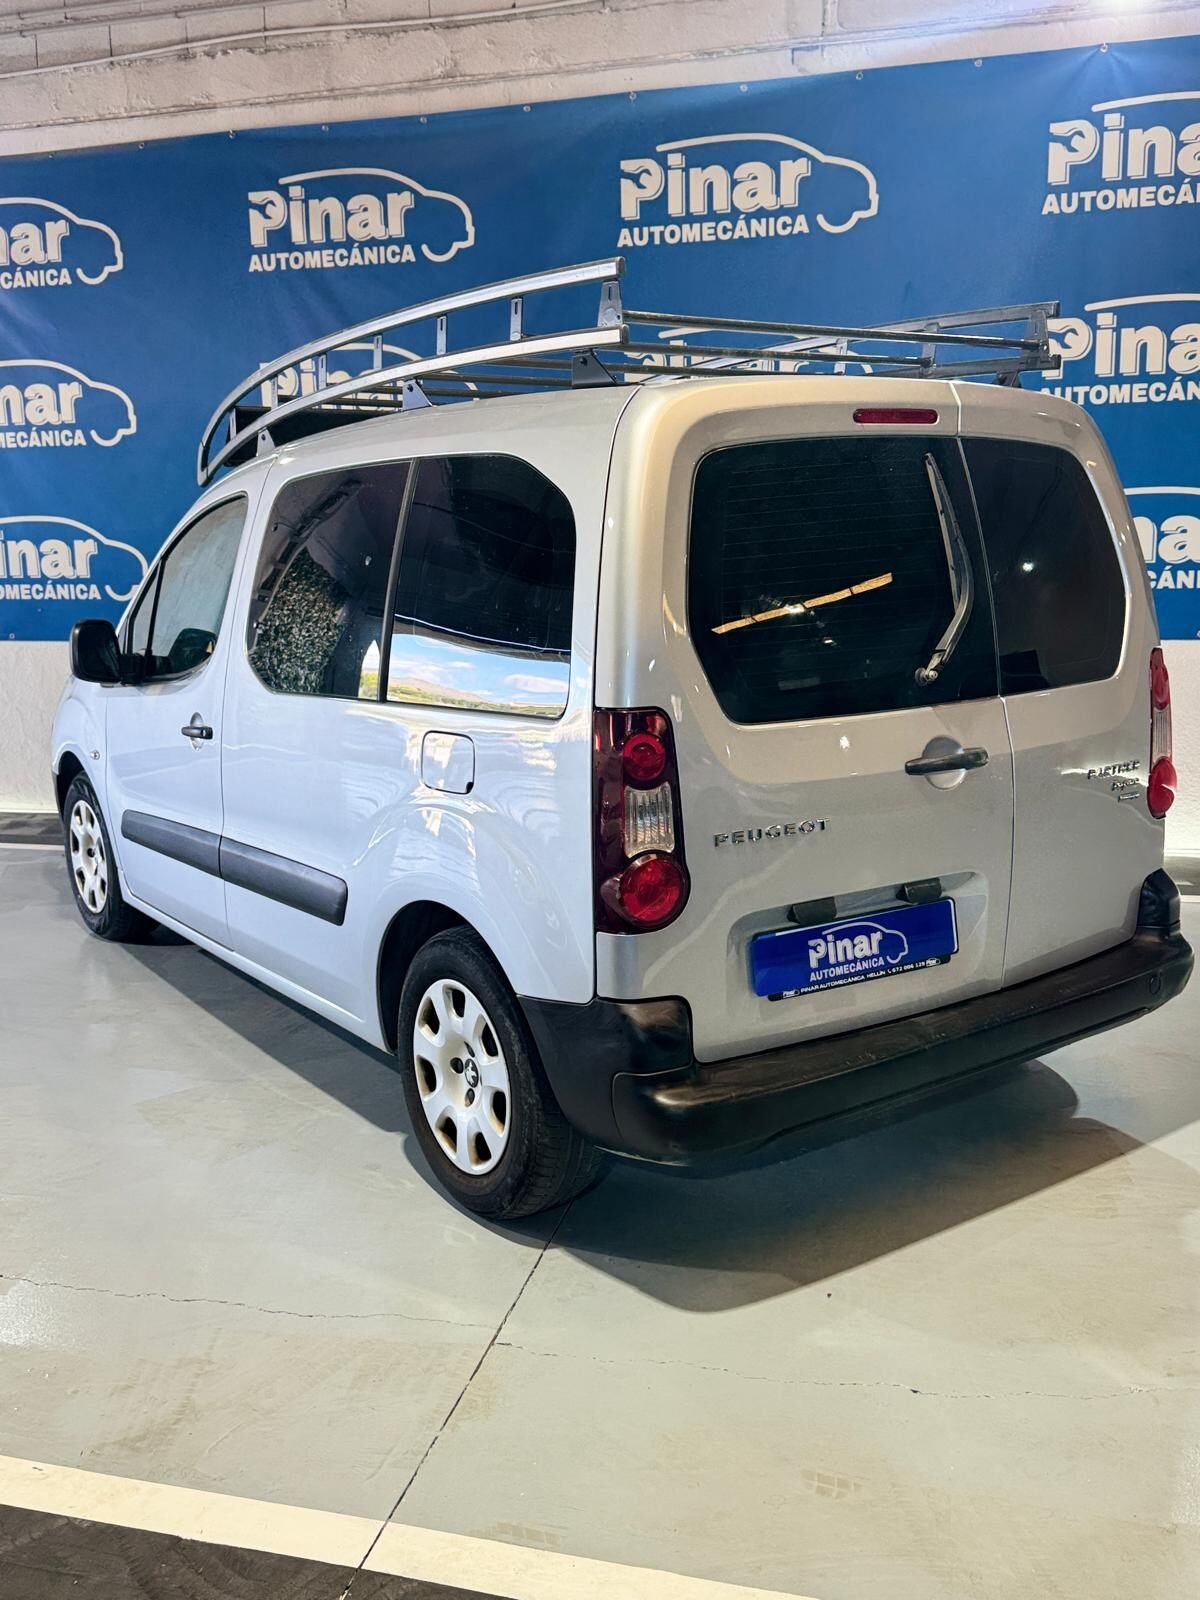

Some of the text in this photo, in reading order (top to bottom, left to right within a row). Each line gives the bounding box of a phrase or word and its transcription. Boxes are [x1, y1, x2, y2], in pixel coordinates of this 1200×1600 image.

[620, 152, 812, 221] Pinar
[1041, 178, 1200, 215] AUTOMECÁ
[247, 185, 415, 248] Pinar
[617, 214, 810, 248] AUTOMECÁNICA
[0, 219, 70, 266] ar
[248, 243, 416, 273] AUTOMECÁNICA
[713, 818, 830, 848] PEUGEOT
[808, 931, 883, 969] Pinar
[809, 957, 885, 982] AUTOMECÁNICA
[801, 984, 820, 993] PINAR
